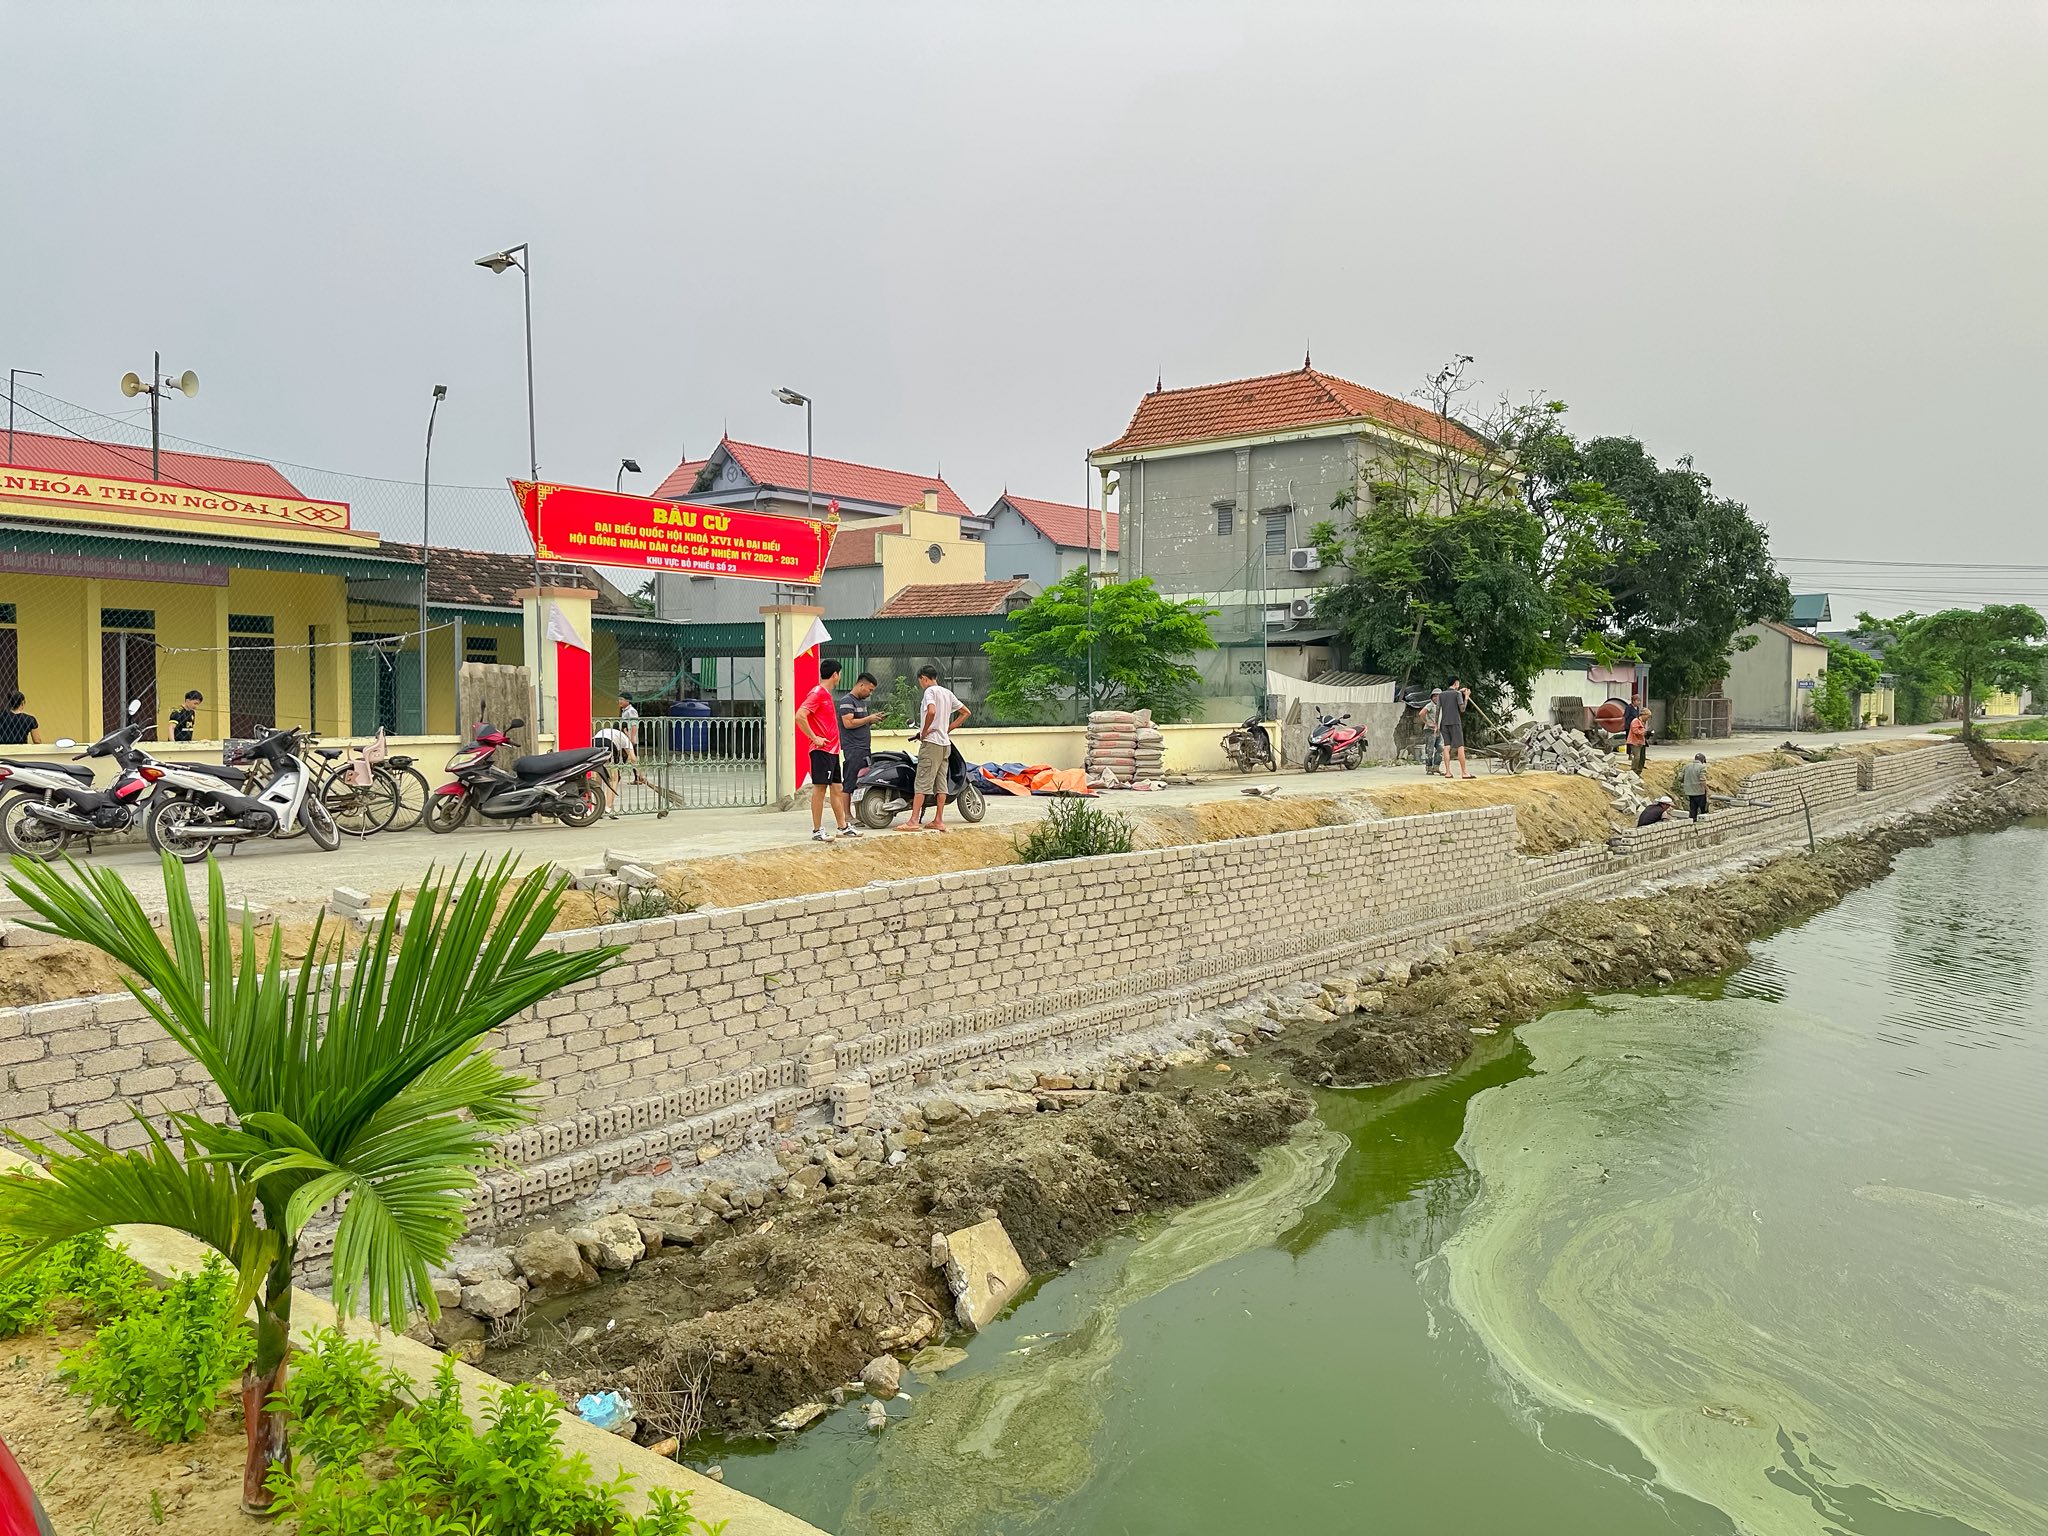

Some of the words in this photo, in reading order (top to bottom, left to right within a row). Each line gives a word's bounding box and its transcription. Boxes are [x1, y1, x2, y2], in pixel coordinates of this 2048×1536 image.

[28, 476, 92, 496] HÓA
[98, 486, 177, 505] THÔN
[280, 506, 290, 518] 1
[653, 505, 697, 528] BẦU
[702, 512, 731, 531] CỬ
[569, 532, 587, 546] HỘI
[589, 533, 617, 548] ĐỒNG
[619, 538, 647, 551] NHÂN
[649, 540, 669, 553] DÂN
[671, 543, 689, 555] CÁC
[691, 544, 709, 557] CẤP
[711, 548, 739, 561] NHIỆM
[753, 552, 774, 564] 2026
[780, 555, 799, 566] 2031
[594, 522, 612, 534] ĐẠI
[614, 522, 637, 536] BIỂU
[639, 526, 664, 539] QUỐC
[666, 529, 682, 542] HỘI
[684, 531, 708, 545] KHOÁ
[710, 535, 732, 546] XVI
[733, 537, 745, 548] VÀ
[746, 540, 761, 551] ĐẠI
[762, 539, 781, 552] BIỂU
[646, 556, 662, 565] KHU
[663, 557, 679, 568] VỰC
[680, 558, 692, 568] BỎ
[693, 559, 715, 570] PHIẾU
[716, 561, 726, 571] SỐ
[727, 564, 737, 572] 23
[827, 770, 832, 780] 7
